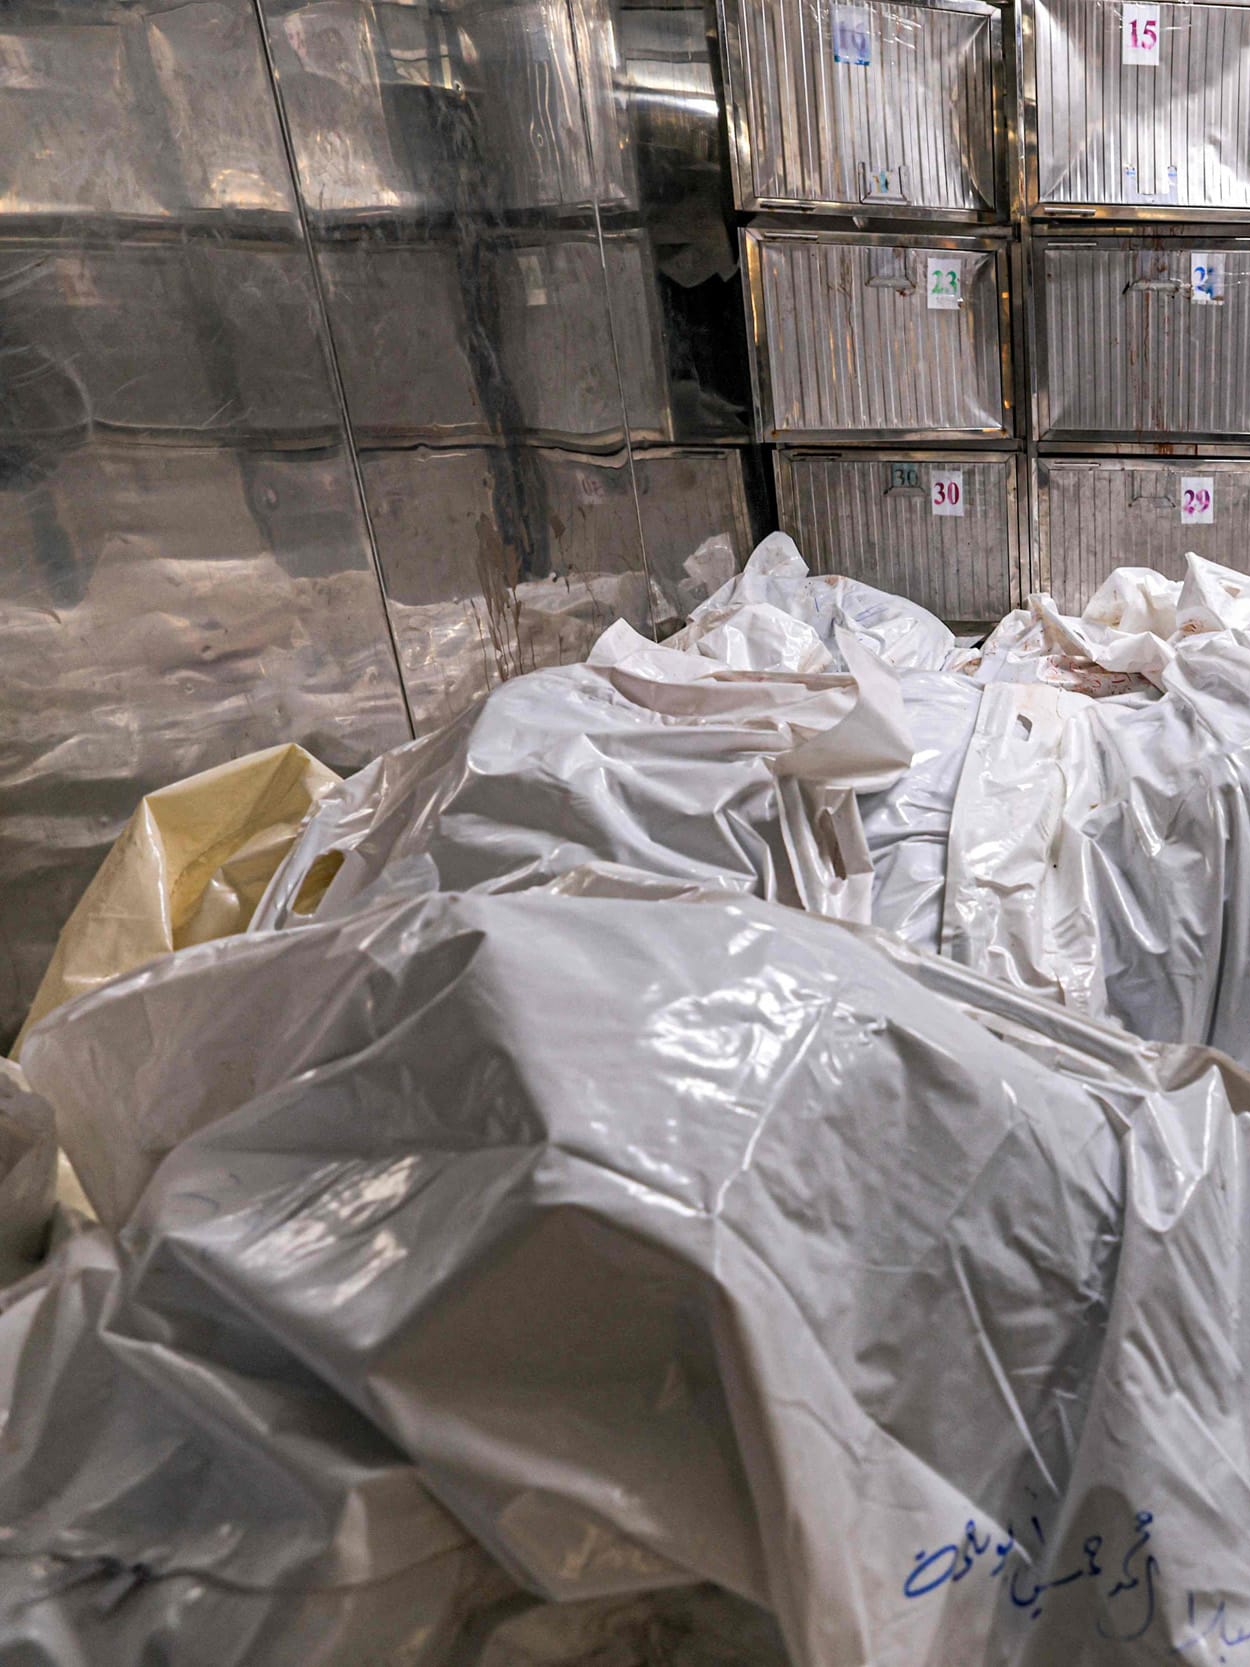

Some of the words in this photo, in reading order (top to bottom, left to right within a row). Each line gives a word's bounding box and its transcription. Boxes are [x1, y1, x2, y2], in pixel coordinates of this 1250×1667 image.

[1127, 19, 1157, 49] 15
[931, 270, 958, 295] 23
[893, 469, 917, 486] 30
[934, 482, 959, 504] 30
[1183, 488, 1210, 514] 29
